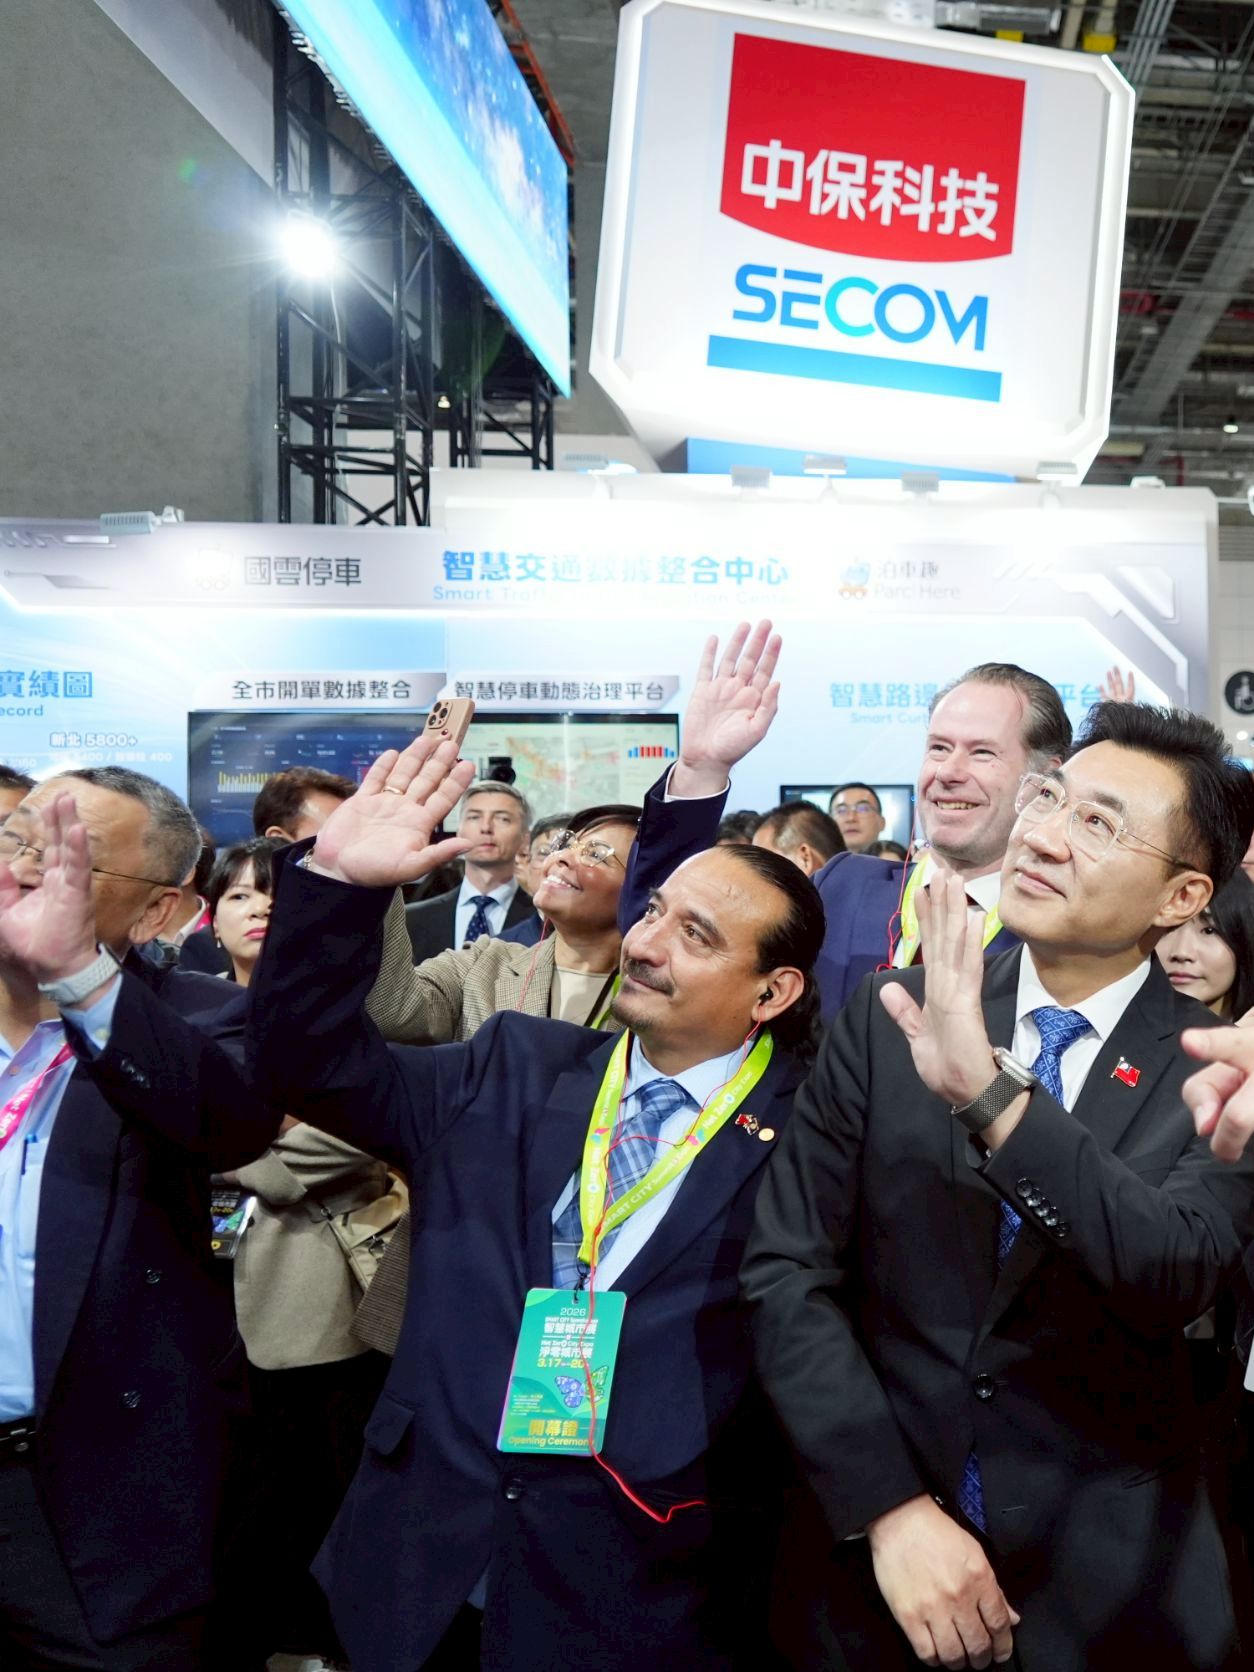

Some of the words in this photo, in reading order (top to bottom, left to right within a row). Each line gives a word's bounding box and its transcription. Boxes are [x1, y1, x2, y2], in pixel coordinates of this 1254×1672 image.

[740, 138, 1000, 243] 中保科技
[732, 262, 990, 352] SECOM
[243, 555, 363, 587] 國雲停車
[433, 585, 494, 602] Smart
[232, 679, 412, 700] 全市開單數據整合
[454, 681, 665, 701] 智慧停車動態治理平台
[850, 711, 893, 724] Smart
[85, 732, 138, 748] 5800+
[602, 1203, 631, 1228] MART
[559, 1307, 587, 1317] 2026
